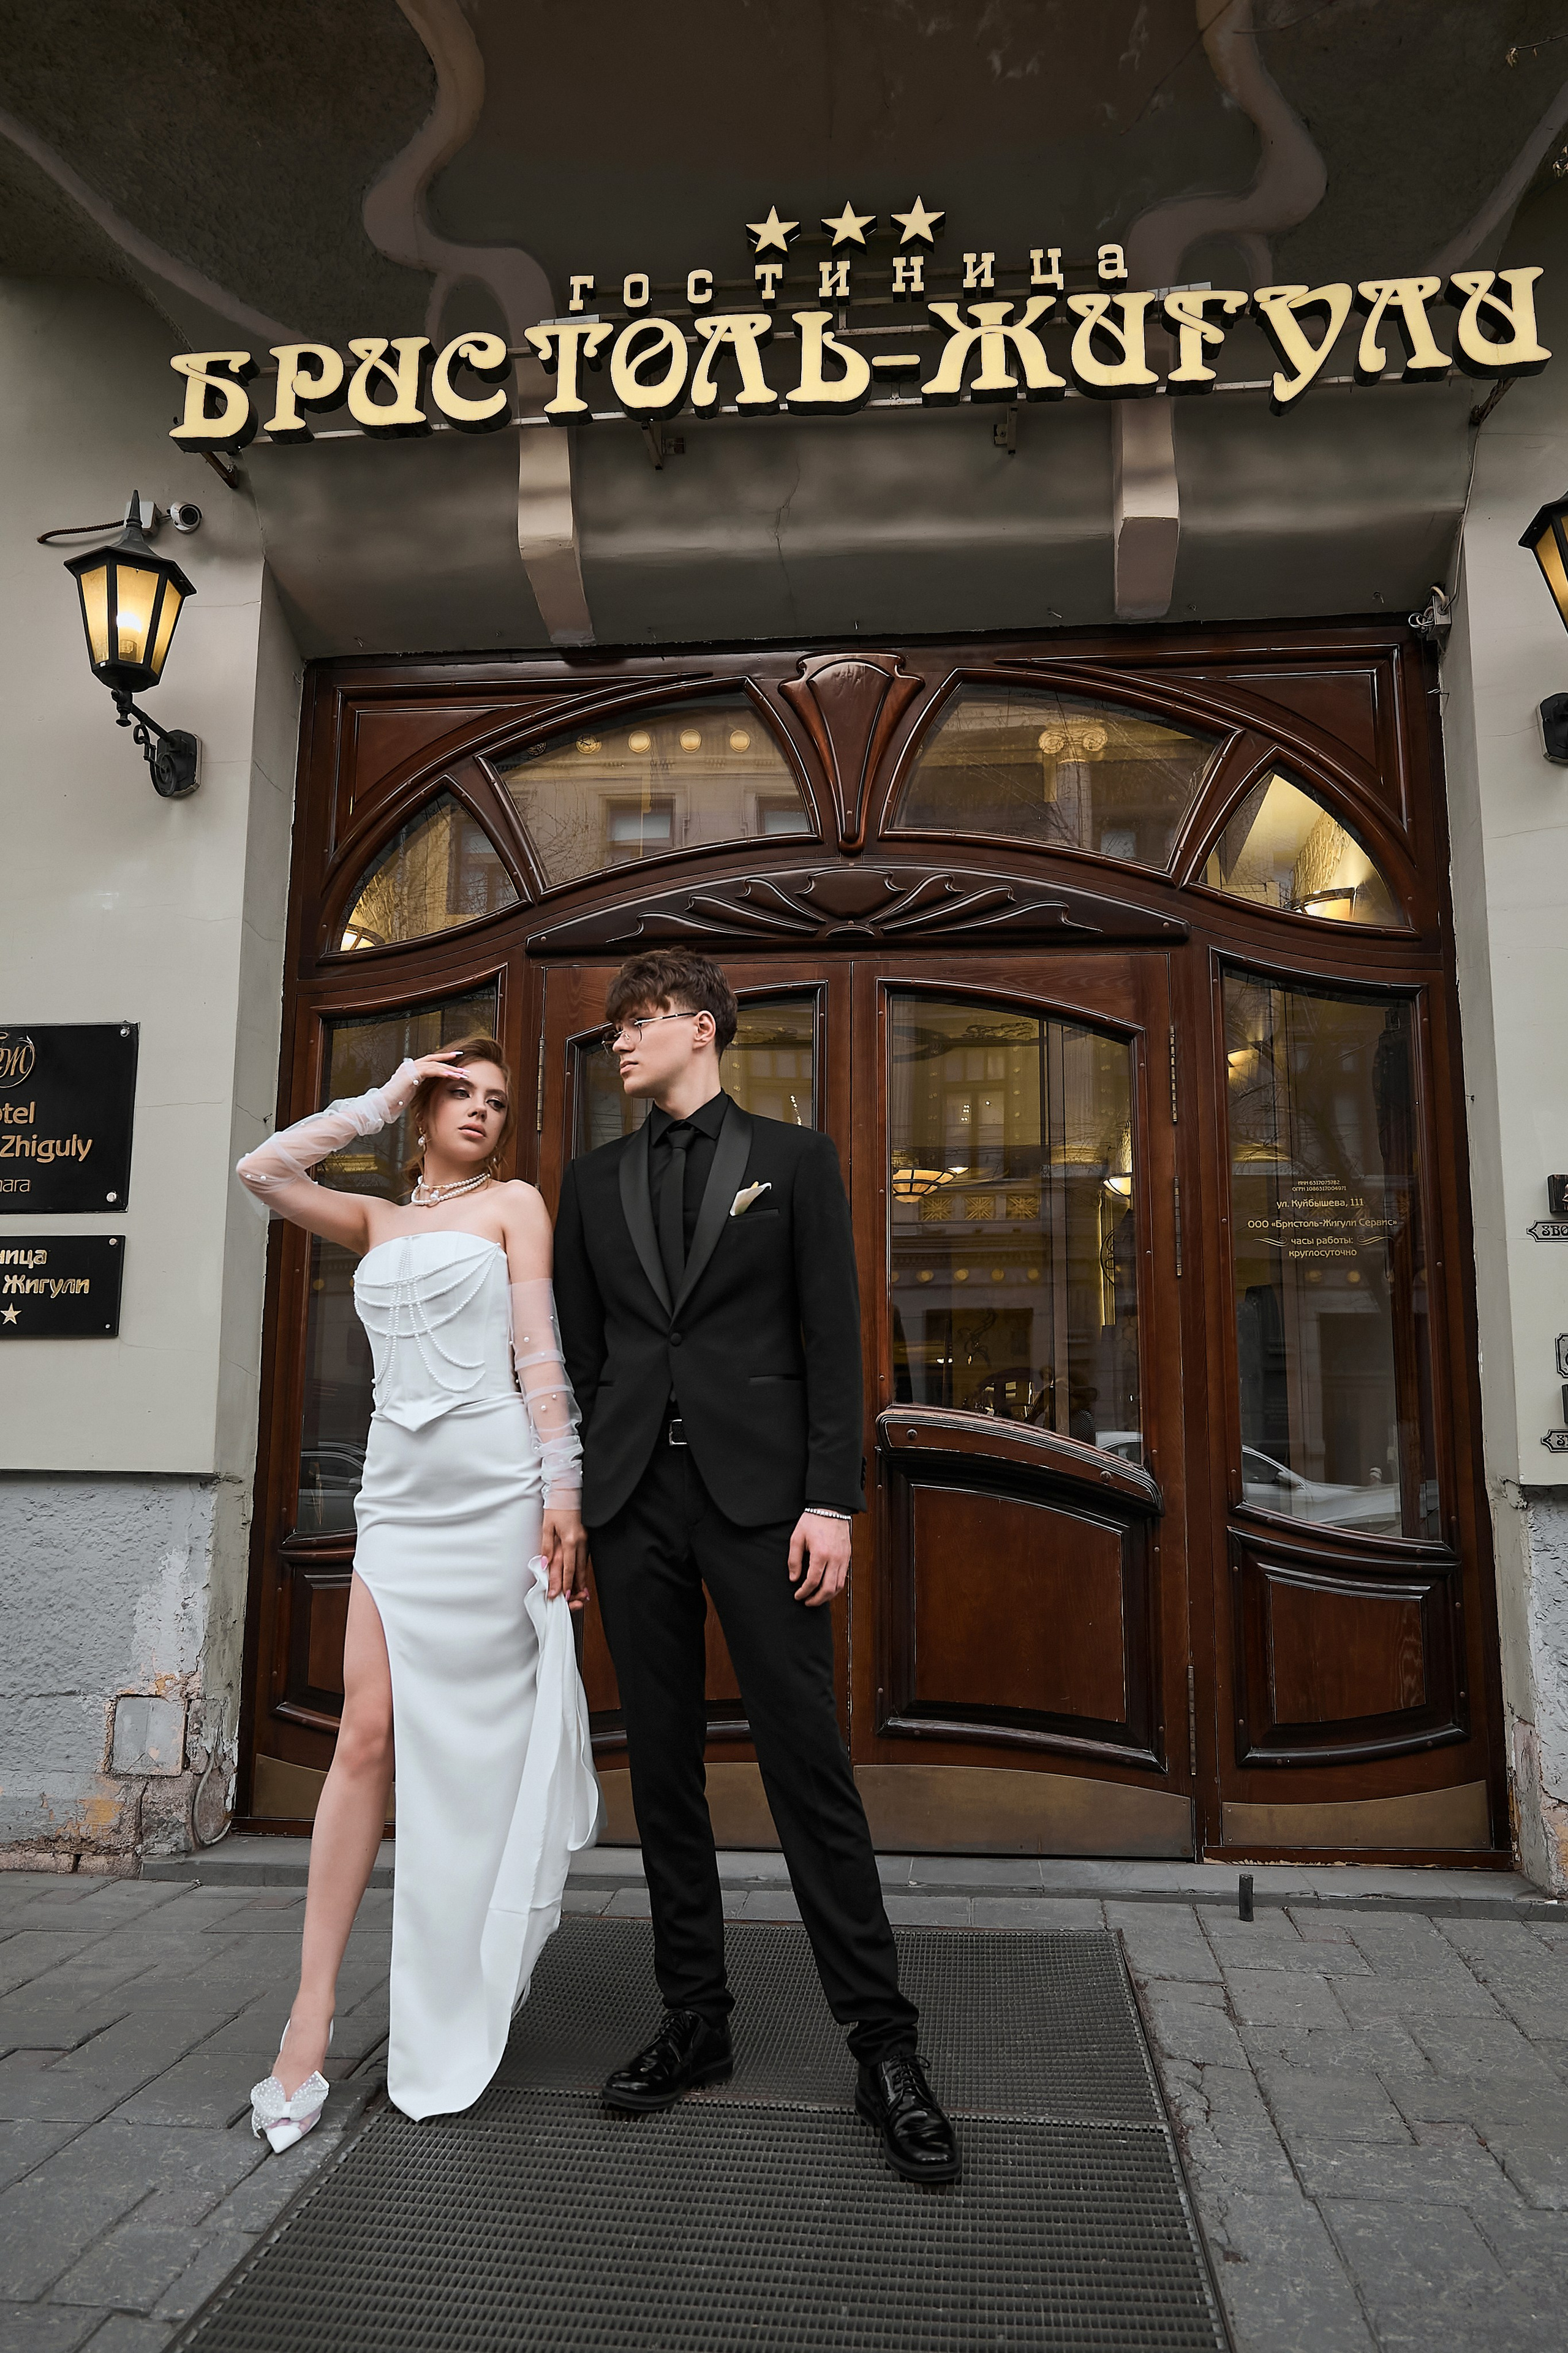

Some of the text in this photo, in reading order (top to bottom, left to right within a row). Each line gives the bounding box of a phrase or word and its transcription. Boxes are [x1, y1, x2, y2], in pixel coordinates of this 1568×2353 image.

[168, 266, 1552, 439] БРИСТОЛЬ-ЖИГУЛИ
[0, 1101, 36, 1124] tel
[0, 1134, 92, 1163] Zhiguly
[0, 1179, 31, 1192] ara
[1276, 1198, 1364, 1209] ул. Куйбышева, 111
[1248, 1218, 1397, 1229] ООО «Бристоль-Жигули Сервис»
[1316, 1236, 1353, 1246] работы:
[1289, 1249, 1357, 1258] круглосуточно
[2, 1275, 90, 1299] Жигули
